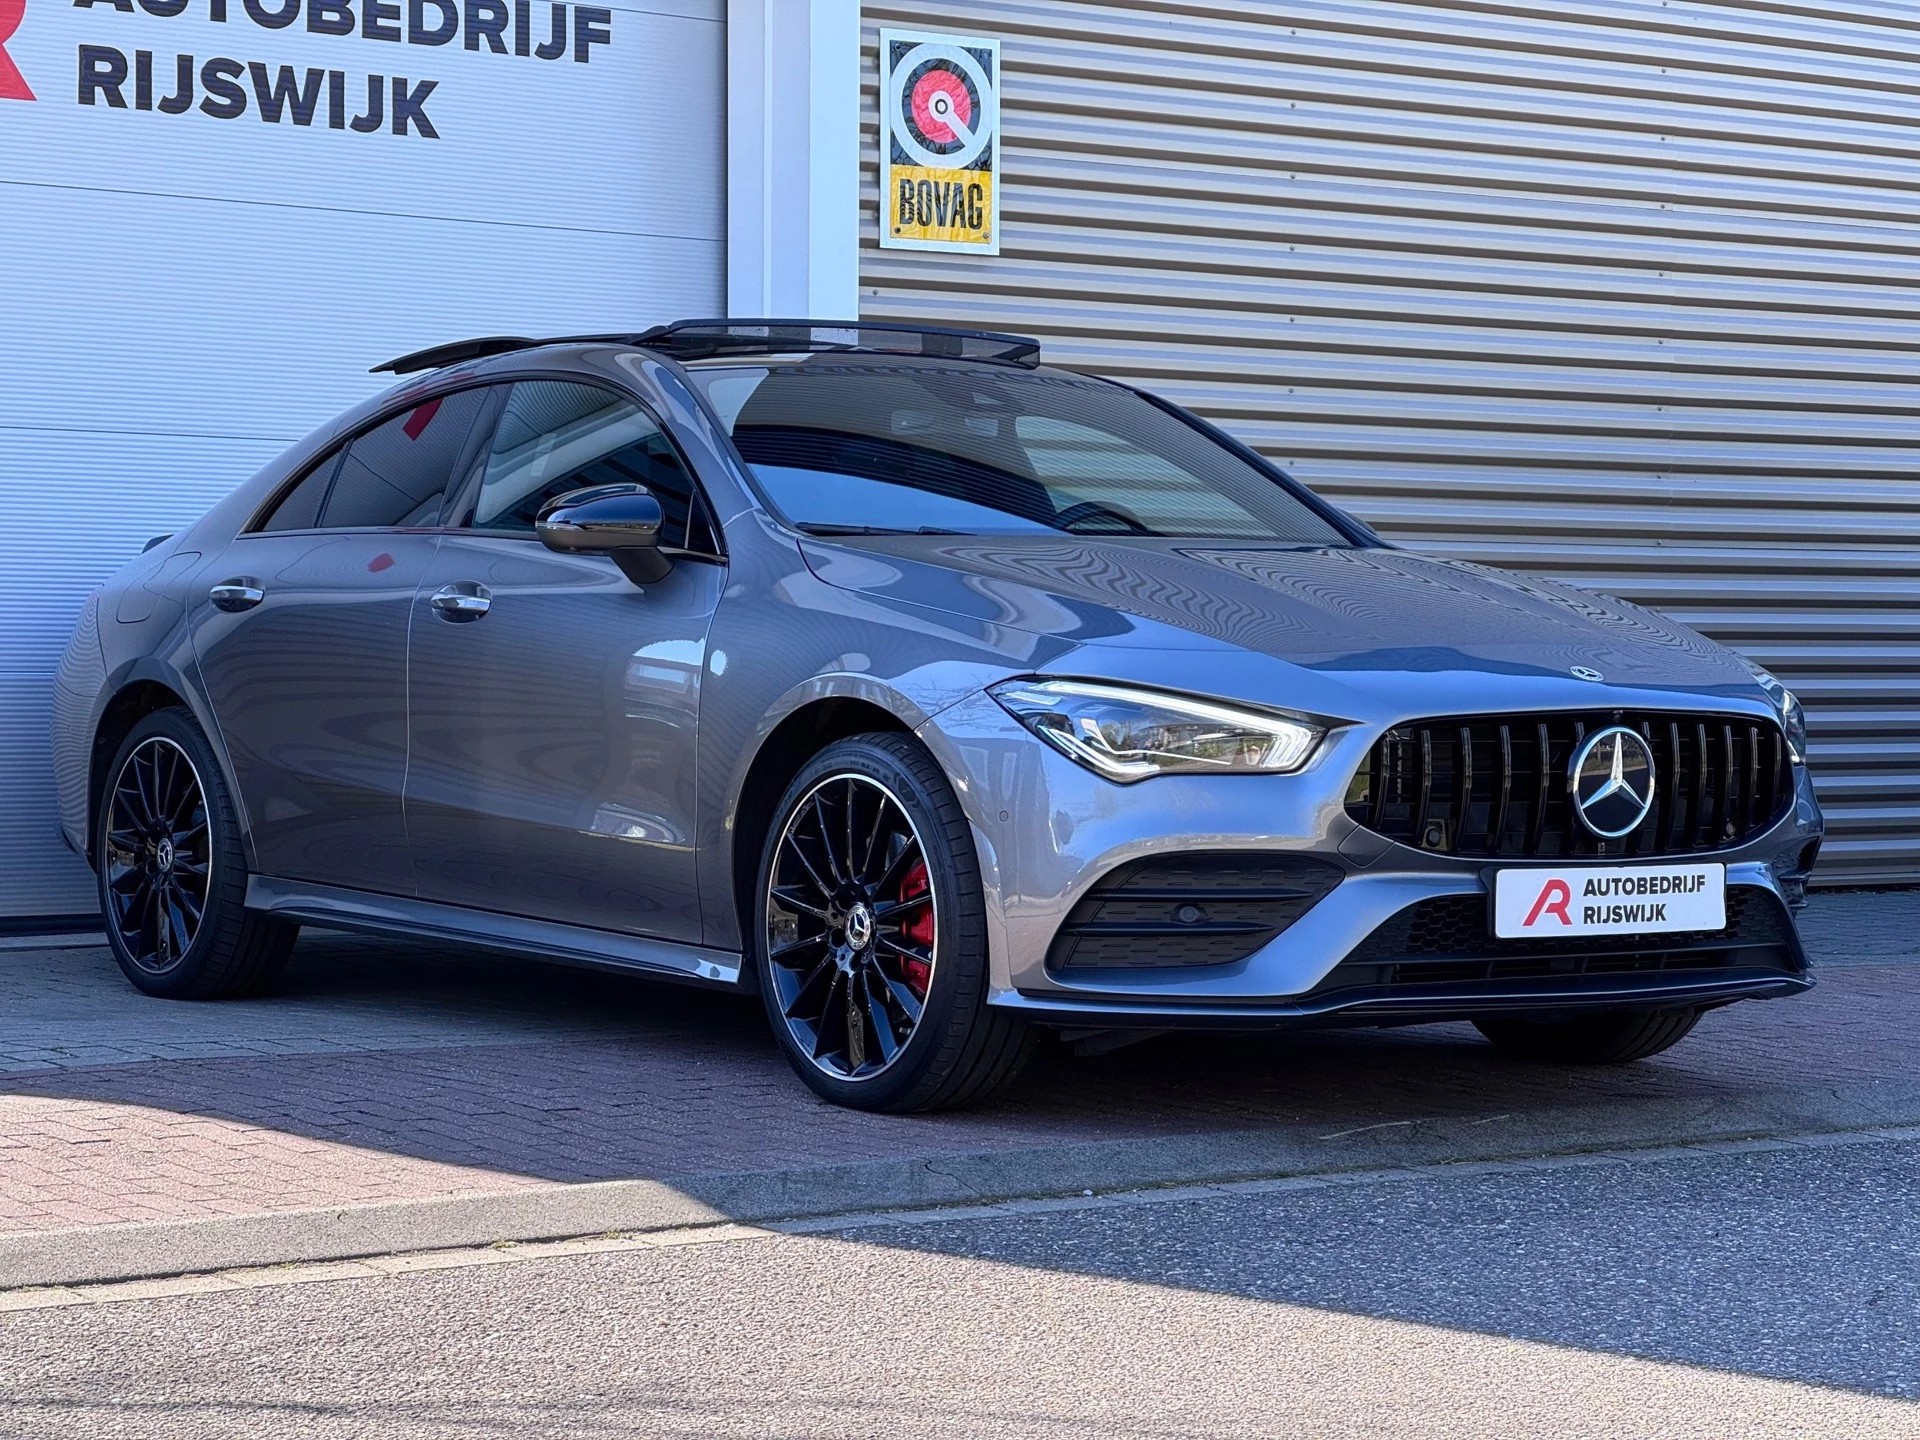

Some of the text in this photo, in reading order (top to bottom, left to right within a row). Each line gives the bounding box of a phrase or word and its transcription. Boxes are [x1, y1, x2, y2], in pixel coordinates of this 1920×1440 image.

[72, 0, 611, 63] BEDRIJF
[78, 44, 440, 139] RIJSWIJK
[900, 178, 983, 230] BOVAG
[1583, 874, 1706, 897] AUTOBEDRIJF
[1583, 903, 1667, 924] RIJSWIJK
